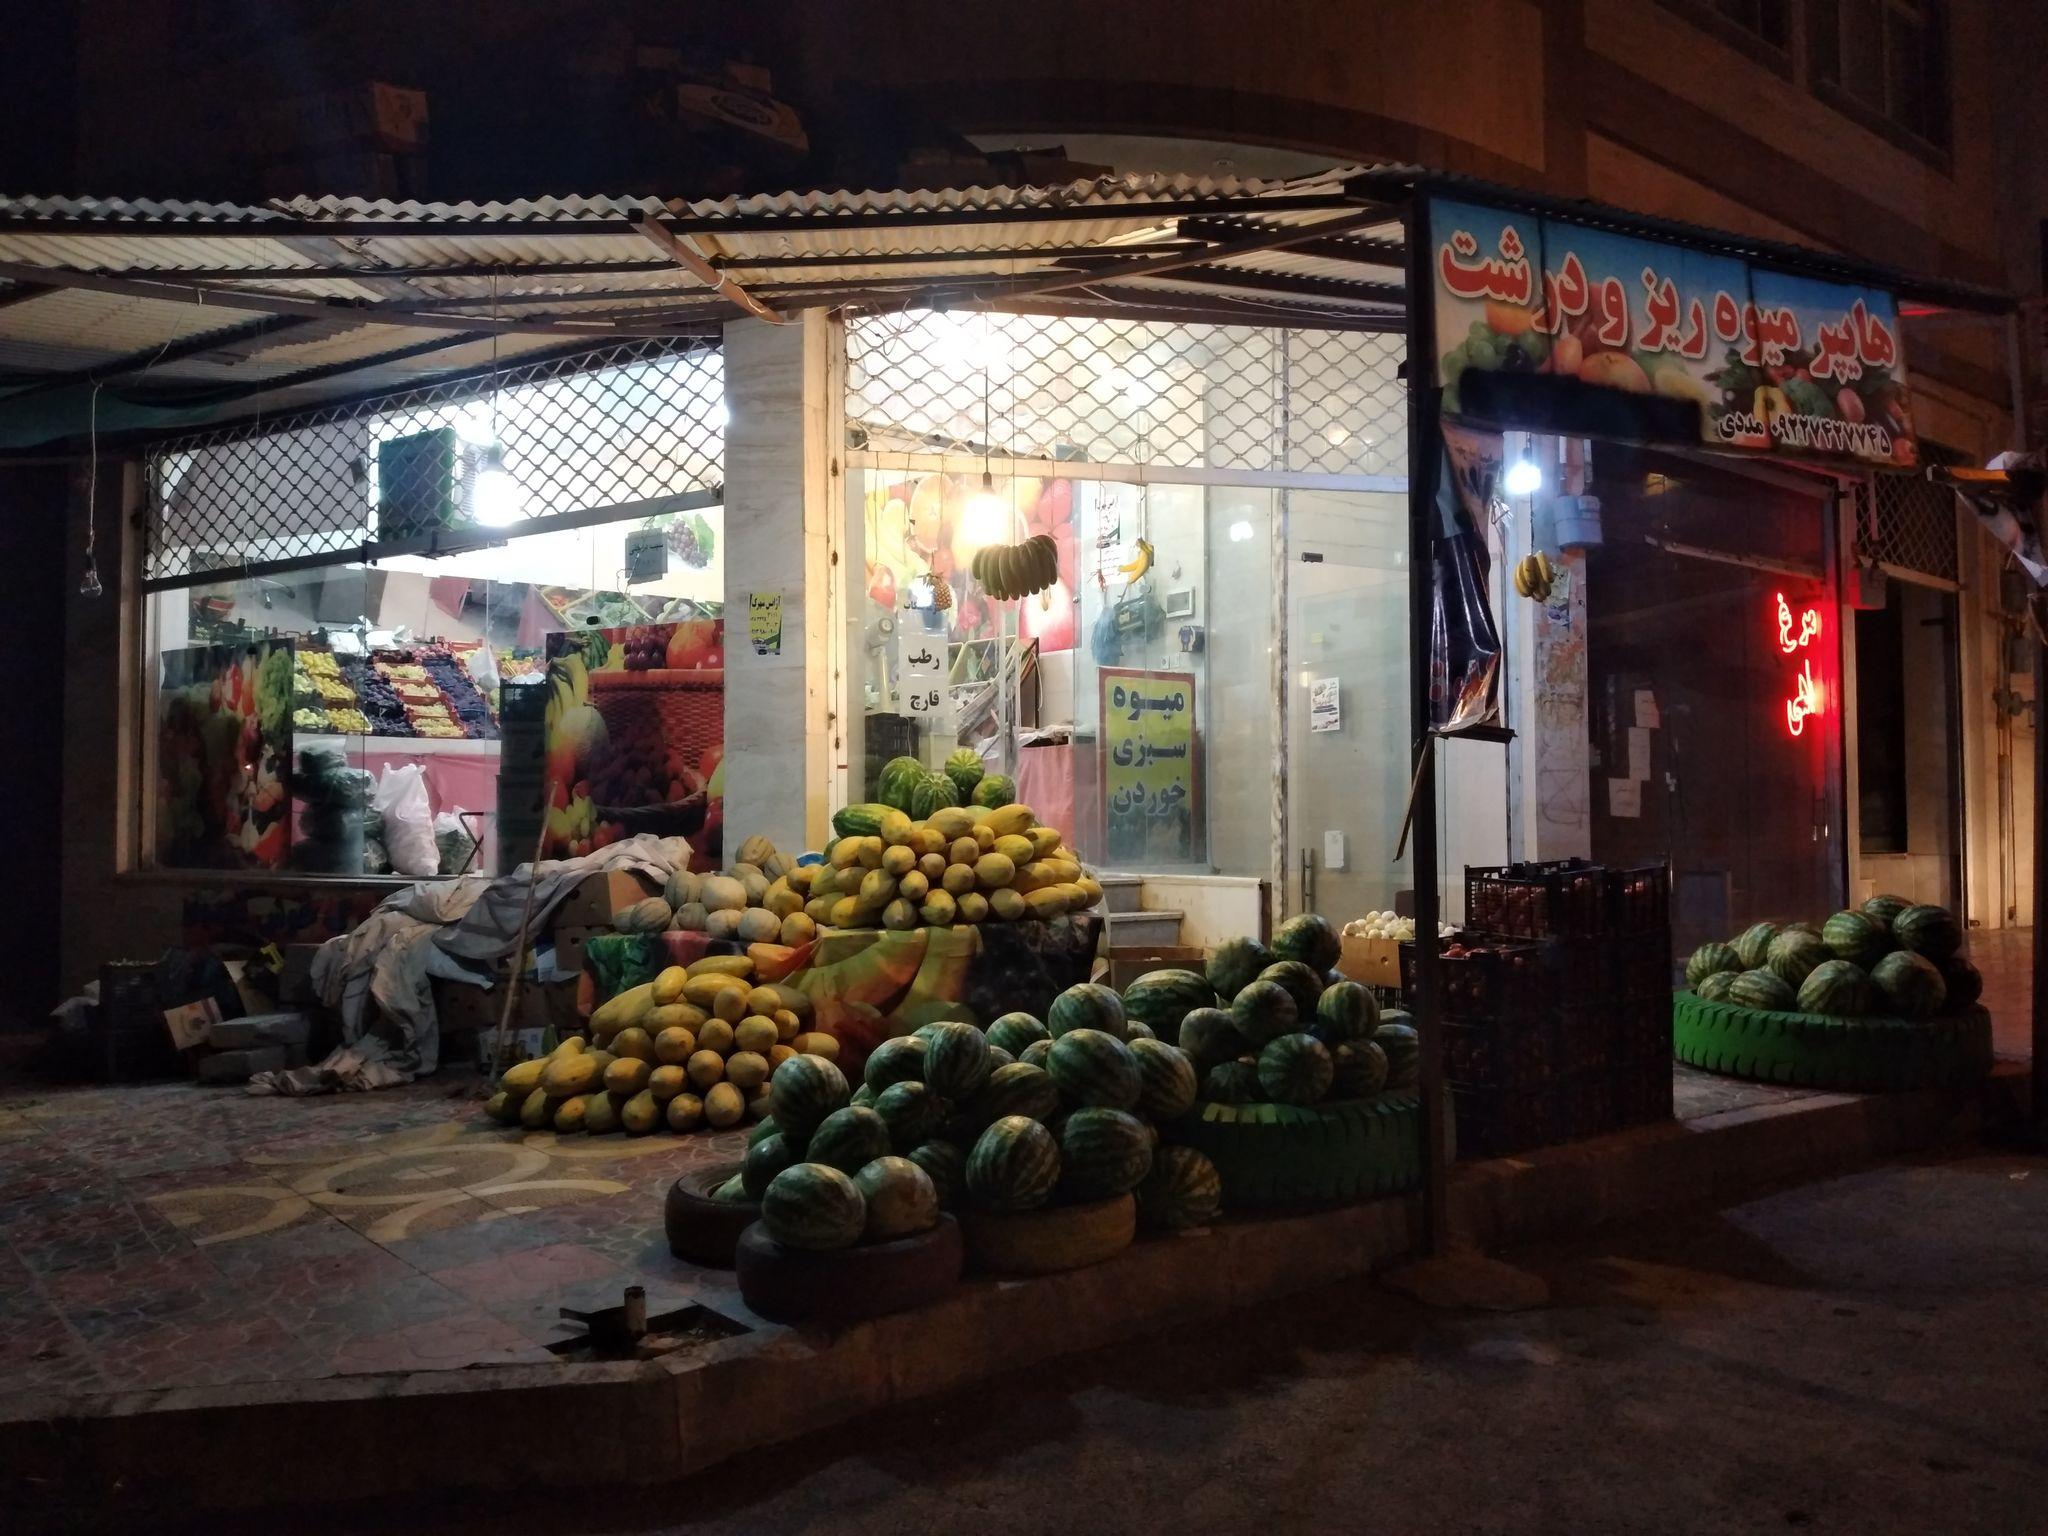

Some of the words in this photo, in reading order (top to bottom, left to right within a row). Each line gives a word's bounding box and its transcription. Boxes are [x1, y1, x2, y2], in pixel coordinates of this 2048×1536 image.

[1440, 226, 1588, 334] درشت
[1600, 277, 1628, 346] و
[1640, 267, 1707, 359] ریز
[1714, 291, 1800, 366] میوه
[1811, 299, 1896, 384] هایپر
[1777, 592, 1817, 653] مرغ
[908, 648, 940, 670] رطب
[910, 690, 940, 711] قارچ
[1113, 685, 1185, 721] میوه
[1113, 734, 1187, 767] سبزی
[1113, 776, 1187, 815] خوردن
